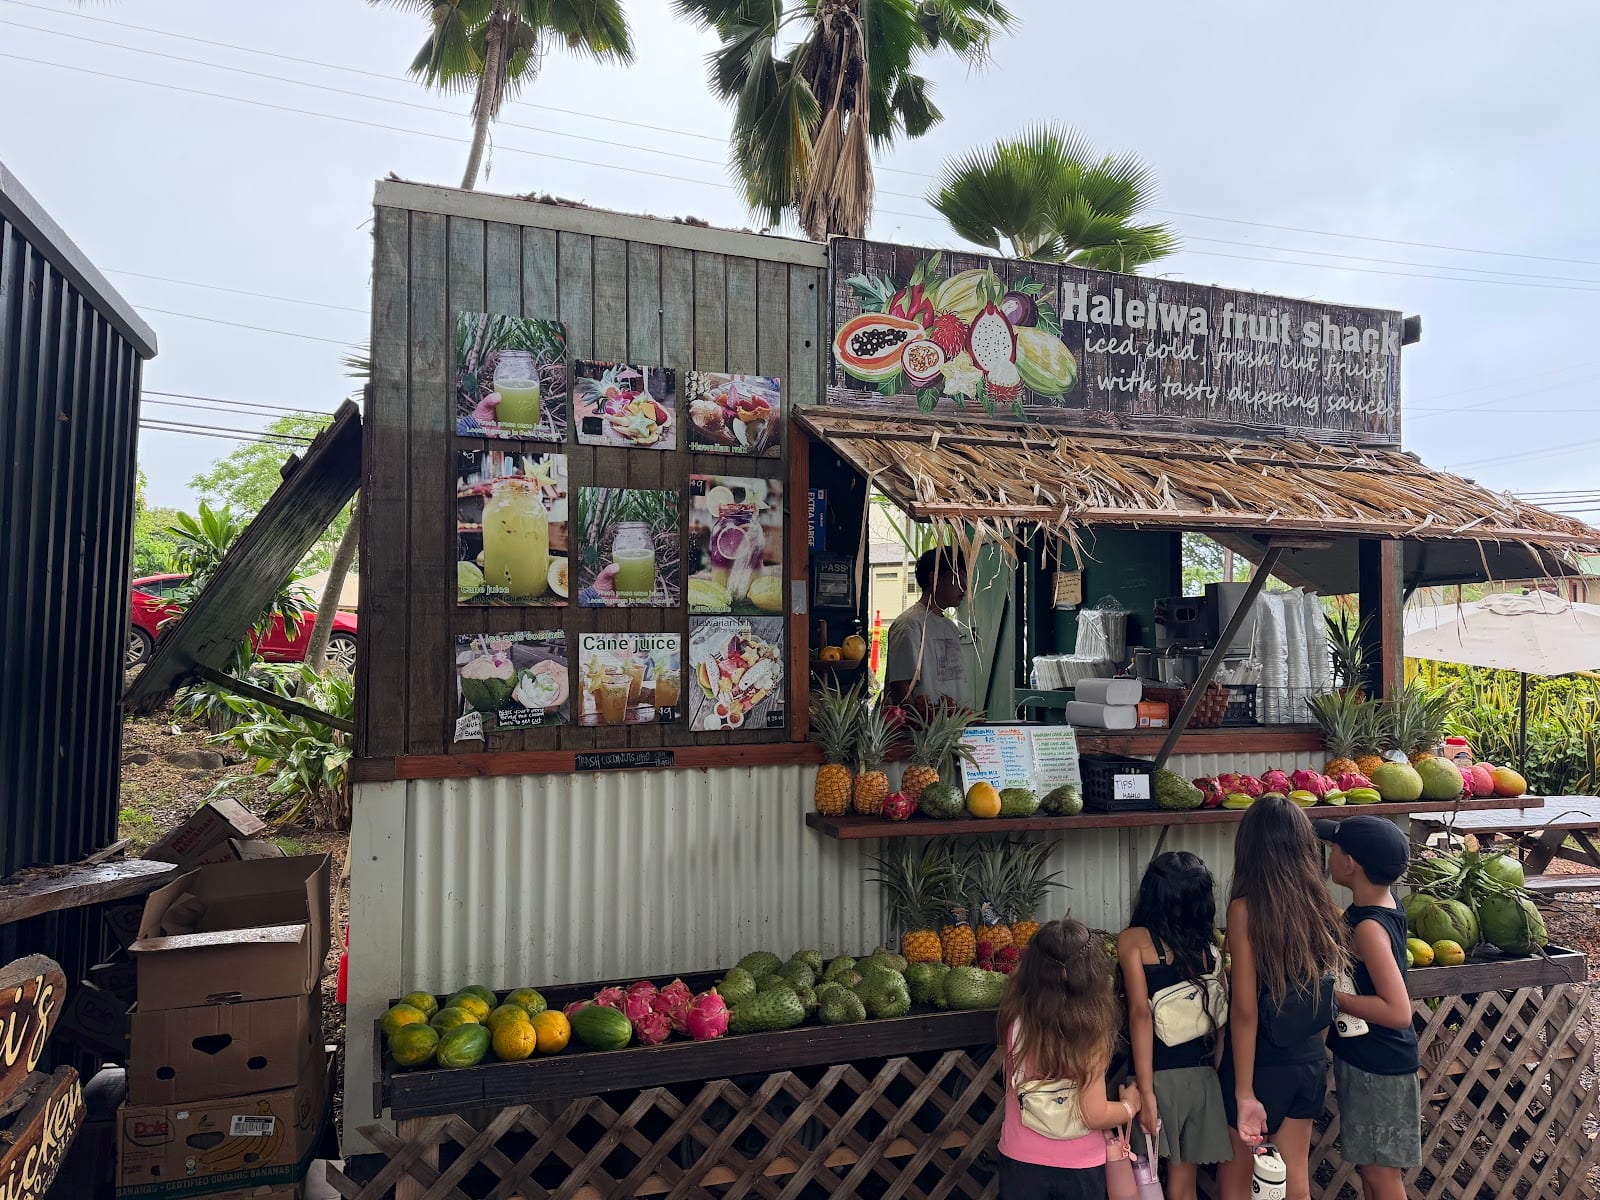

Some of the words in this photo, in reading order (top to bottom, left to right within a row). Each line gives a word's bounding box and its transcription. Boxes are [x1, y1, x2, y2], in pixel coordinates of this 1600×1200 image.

[1062, 281, 1208, 335] Haleiwa
[1222, 302, 1291, 345] fruit
[1302, 315, 1399, 356] shack
[1085, 328, 1138, 355] iced
[1146, 337, 1206, 365] cold,
[1214, 341, 1273, 369] fresh
[1280, 352, 1318, 372] cut
[1325, 355, 1388, 382] fruits
[1098, 369, 1156, 394] with
[1162, 375, 1220, 406] tasty
[1228, 381, 1319, 415] dipping
[821, 564, 849, 573] PASS
[583, 636, 628, 651] Cane
[633, 636, 676, 654] juice
[0, 974, 56, 1073] i's
[134, 1120, 169, 1135] Dole
[116, 1184, 158, 1197] BANANAS
[166, 1178, 209, 1191] CERTIFIED
[211, 1172, 249, 1185] ORGANIC
[250, 1165, 290, 1178] BANANAS
